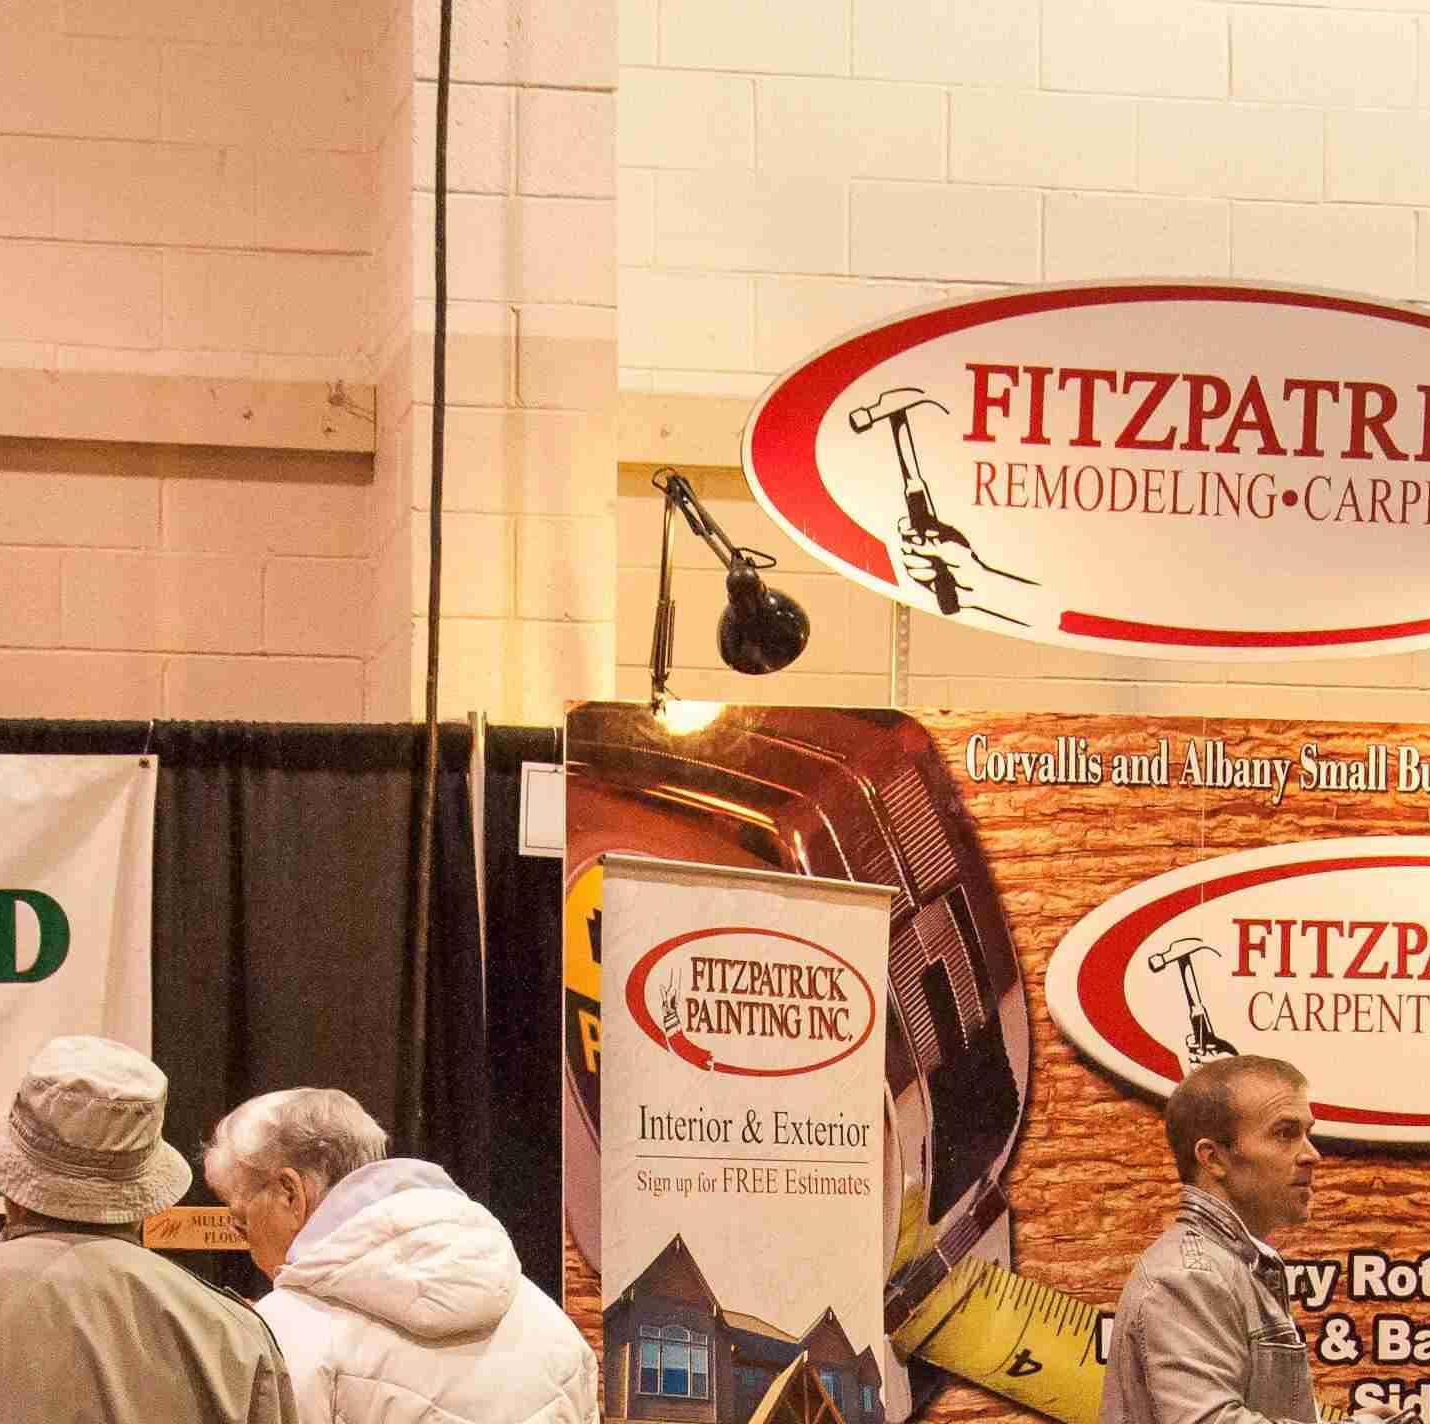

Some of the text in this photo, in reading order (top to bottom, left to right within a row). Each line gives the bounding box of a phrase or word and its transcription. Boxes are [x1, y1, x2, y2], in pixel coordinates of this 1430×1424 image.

[965, 735, 1103, 785] Corvallis
[1112, 739, 1170, 787] and
[1179, 739, 1292, 805] Albany
[1299, 743, 1388, 793] Small
[690, 956, 848, 1002] FITZPATRICK
[684, 998, 854, 1043] PAINTING INC.
[638, 1104, 871, 1148] Interior & Exterior
[636, 1167, 871, 1198] Sign up for FREE Estimates
[1321, 1318, 1359, 1361] &
